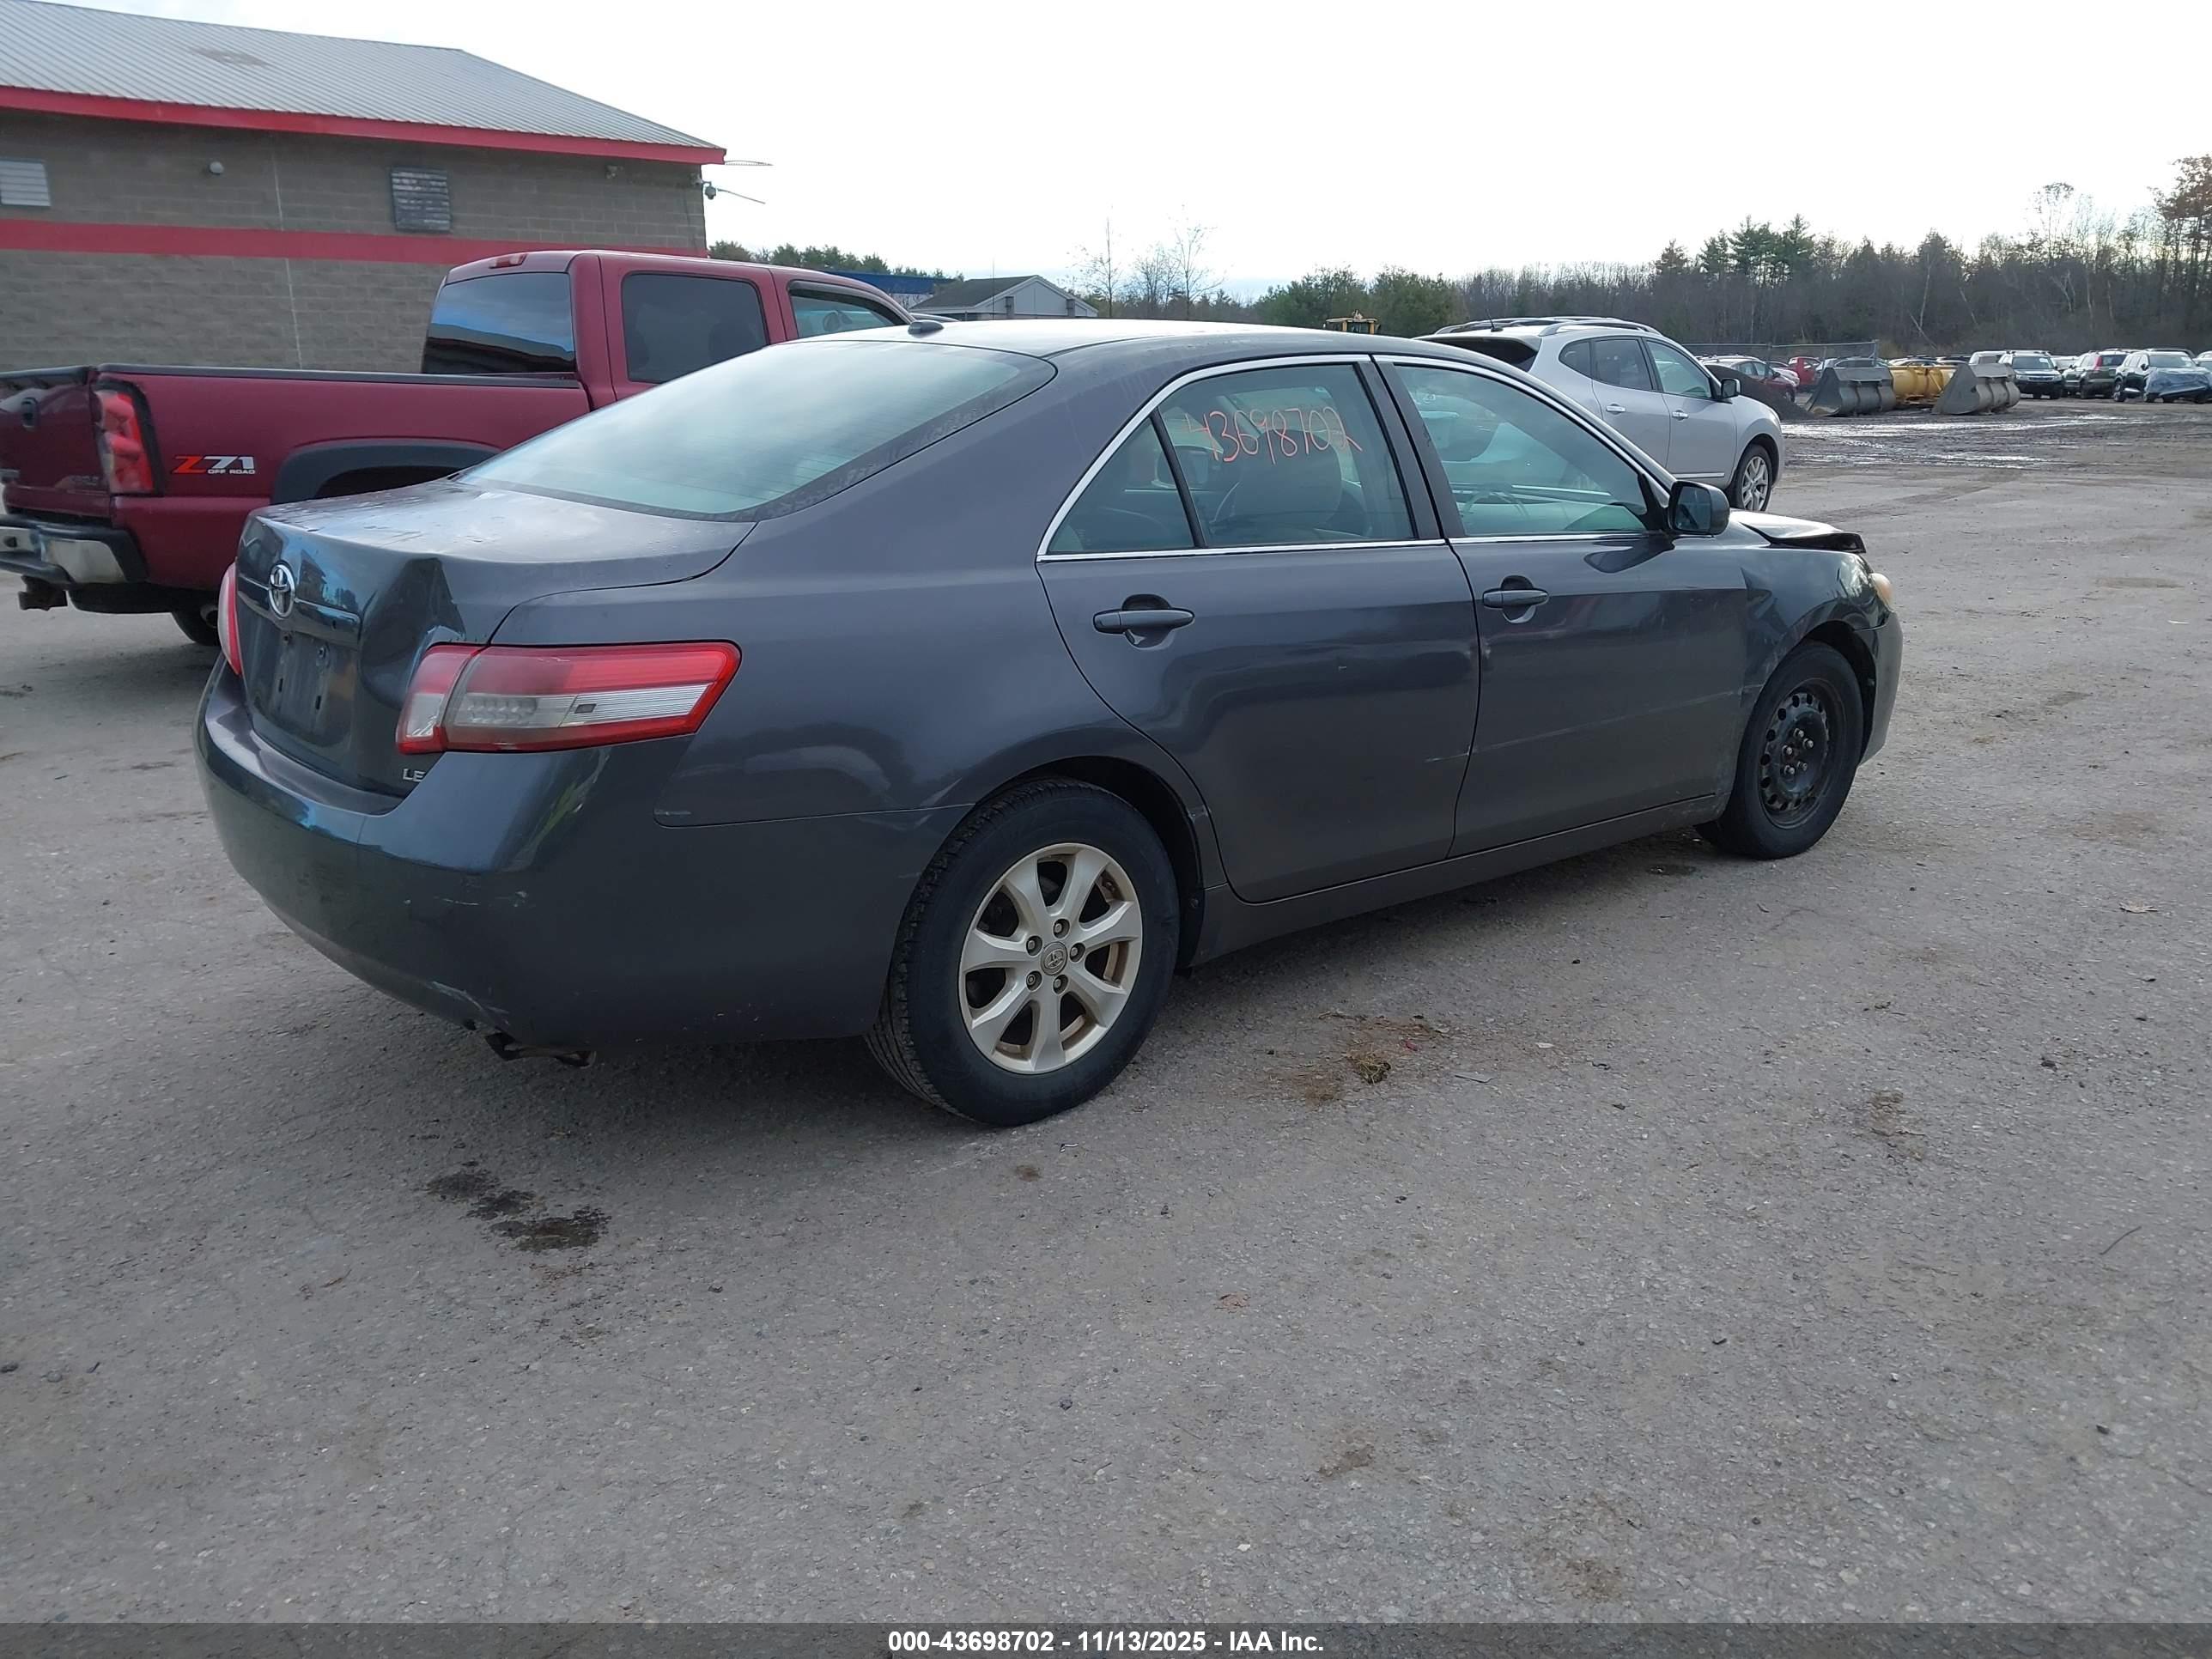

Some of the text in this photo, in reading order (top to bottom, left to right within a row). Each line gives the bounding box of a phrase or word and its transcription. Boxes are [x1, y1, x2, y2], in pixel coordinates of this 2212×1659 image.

[1182, 407, 1363, 465] 43698702
[173, 456, 254, 473] Z71
[403, 769, 426, 782] LE
